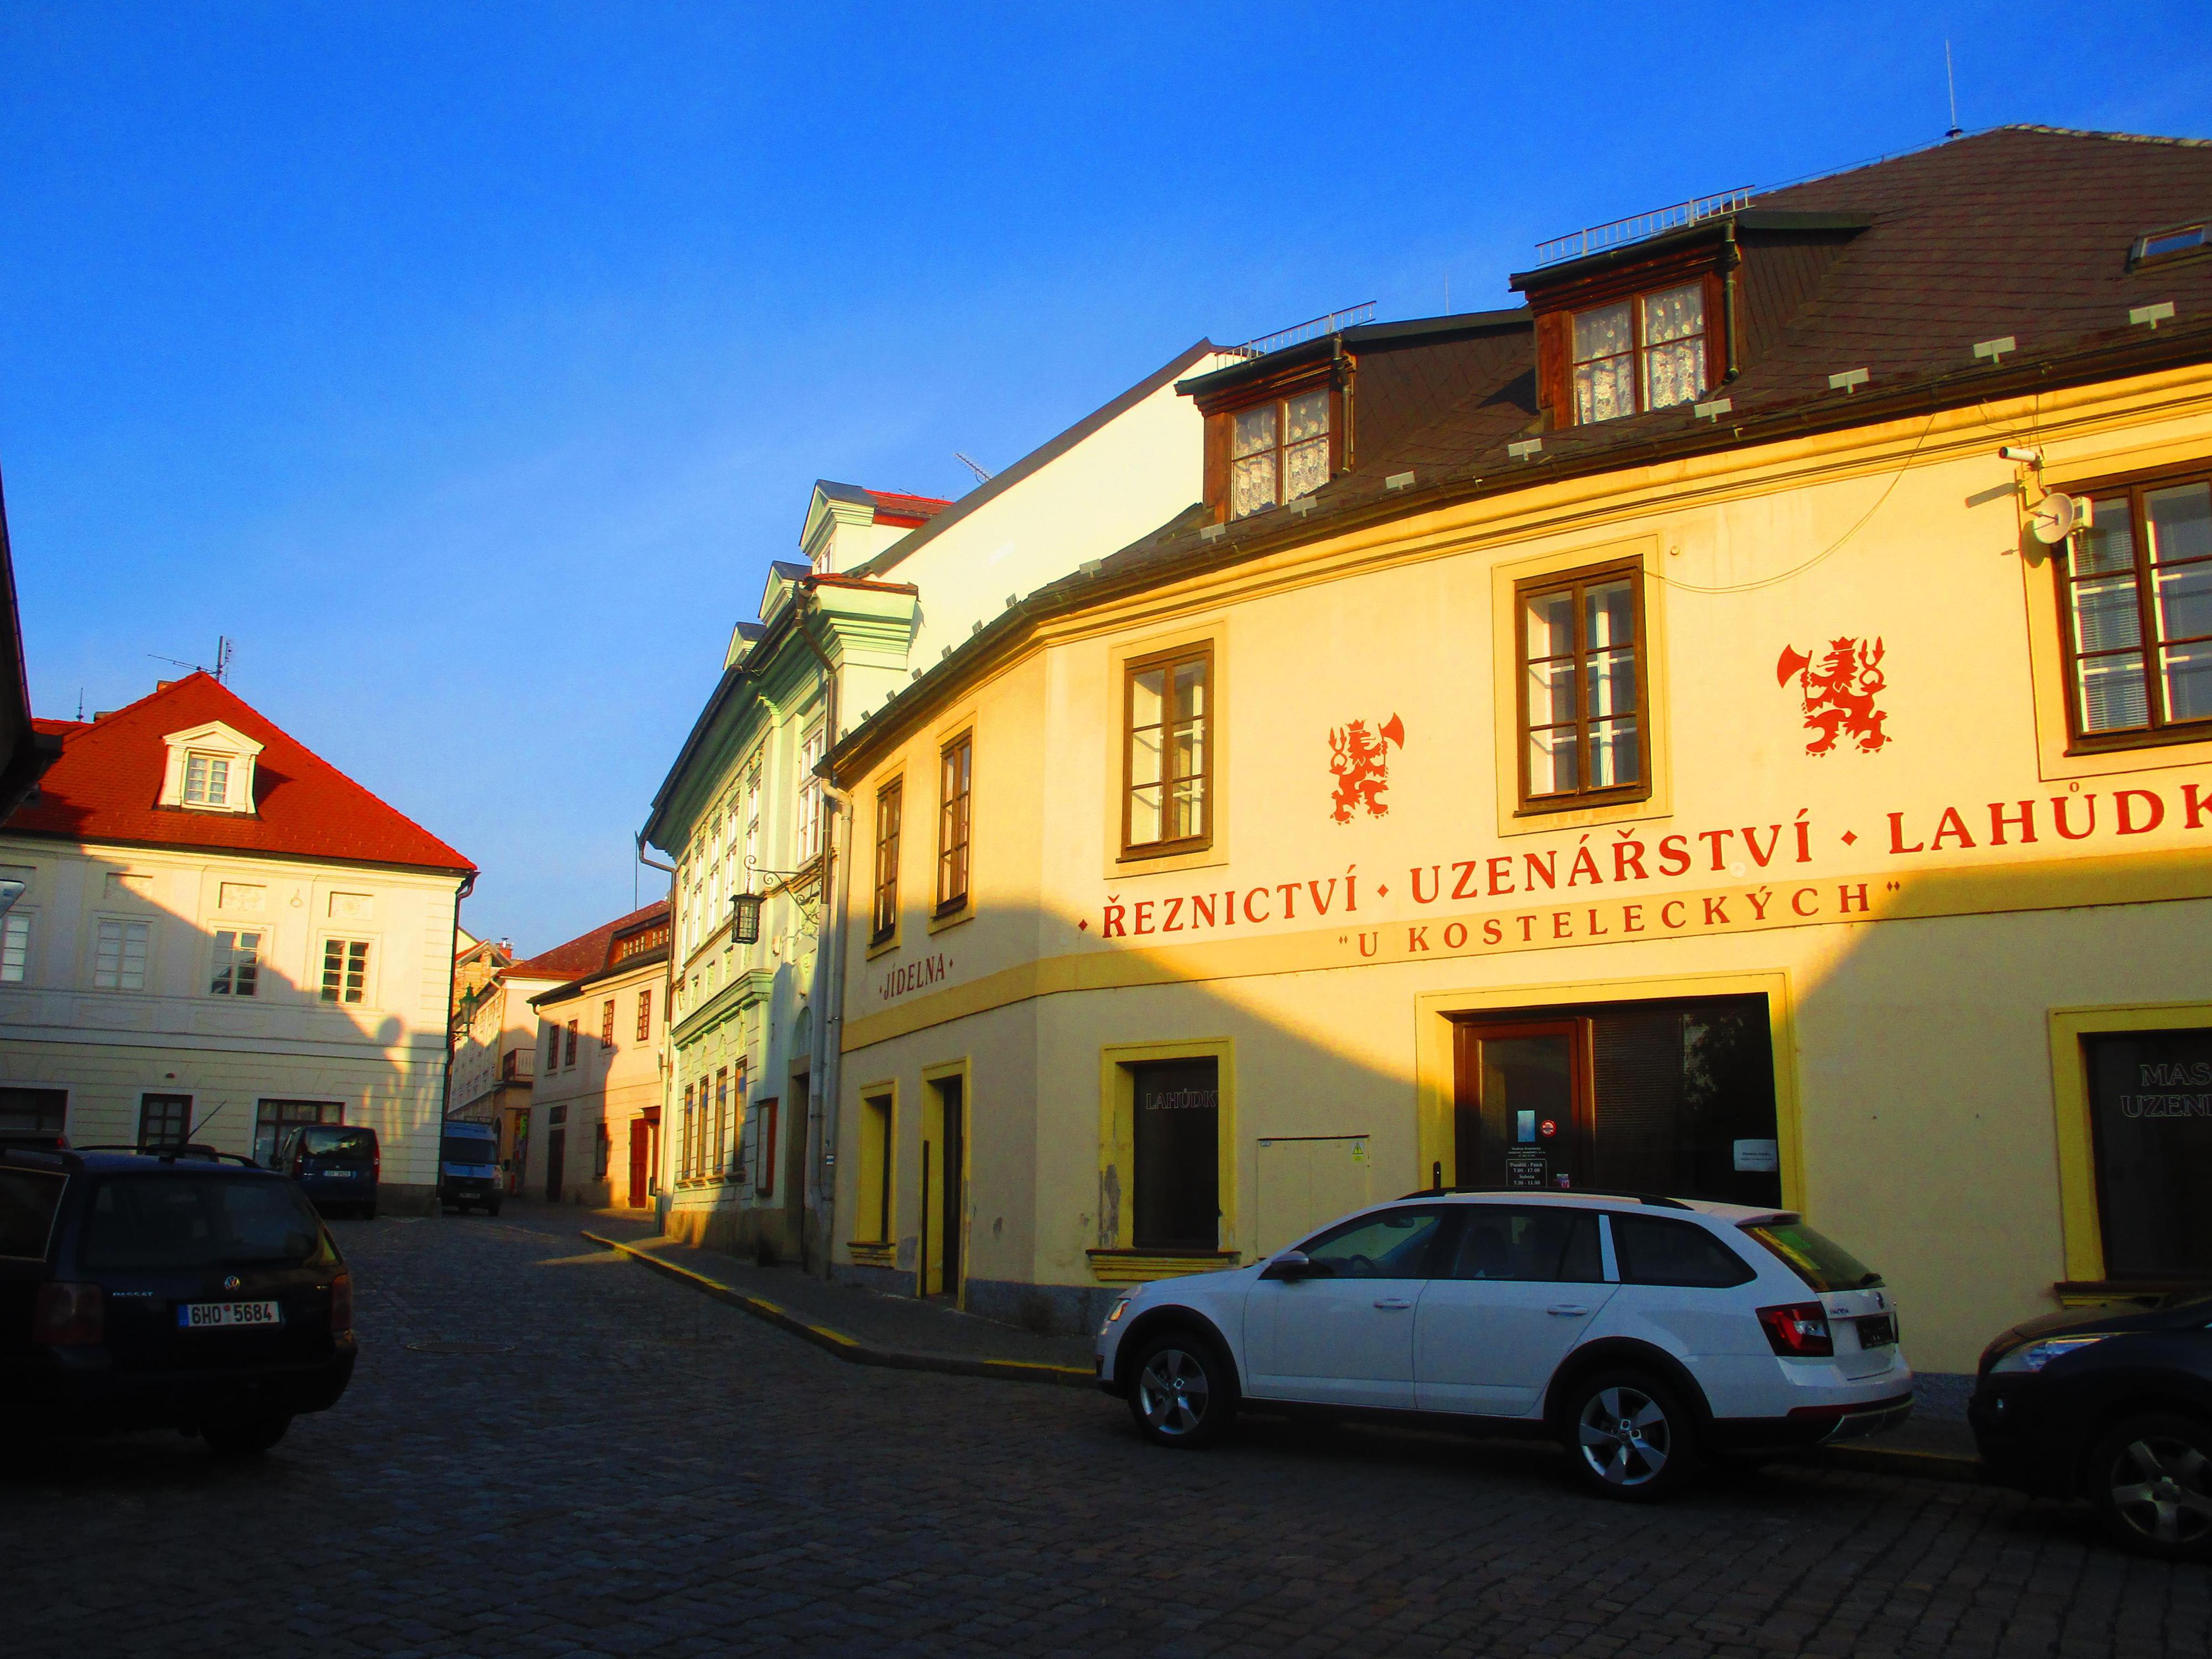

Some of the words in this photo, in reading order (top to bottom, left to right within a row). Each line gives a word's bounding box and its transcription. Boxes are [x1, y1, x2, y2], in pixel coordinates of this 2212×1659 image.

[1102, 864, 1358, 938] ŘEZNICTVÍ
[1410, 808, 1812, 904] UZENÁŘSTVÍ
[1886, 781, 2212, 854] LAHŮDK
[883, 952, 945, 1001] JÍDELNA
[2138, 1062, 2212, 1087] MAS
[1145, 1087, 1218, 1110] LAHŮDK
[233, 1303, 272, 1323] 5684
